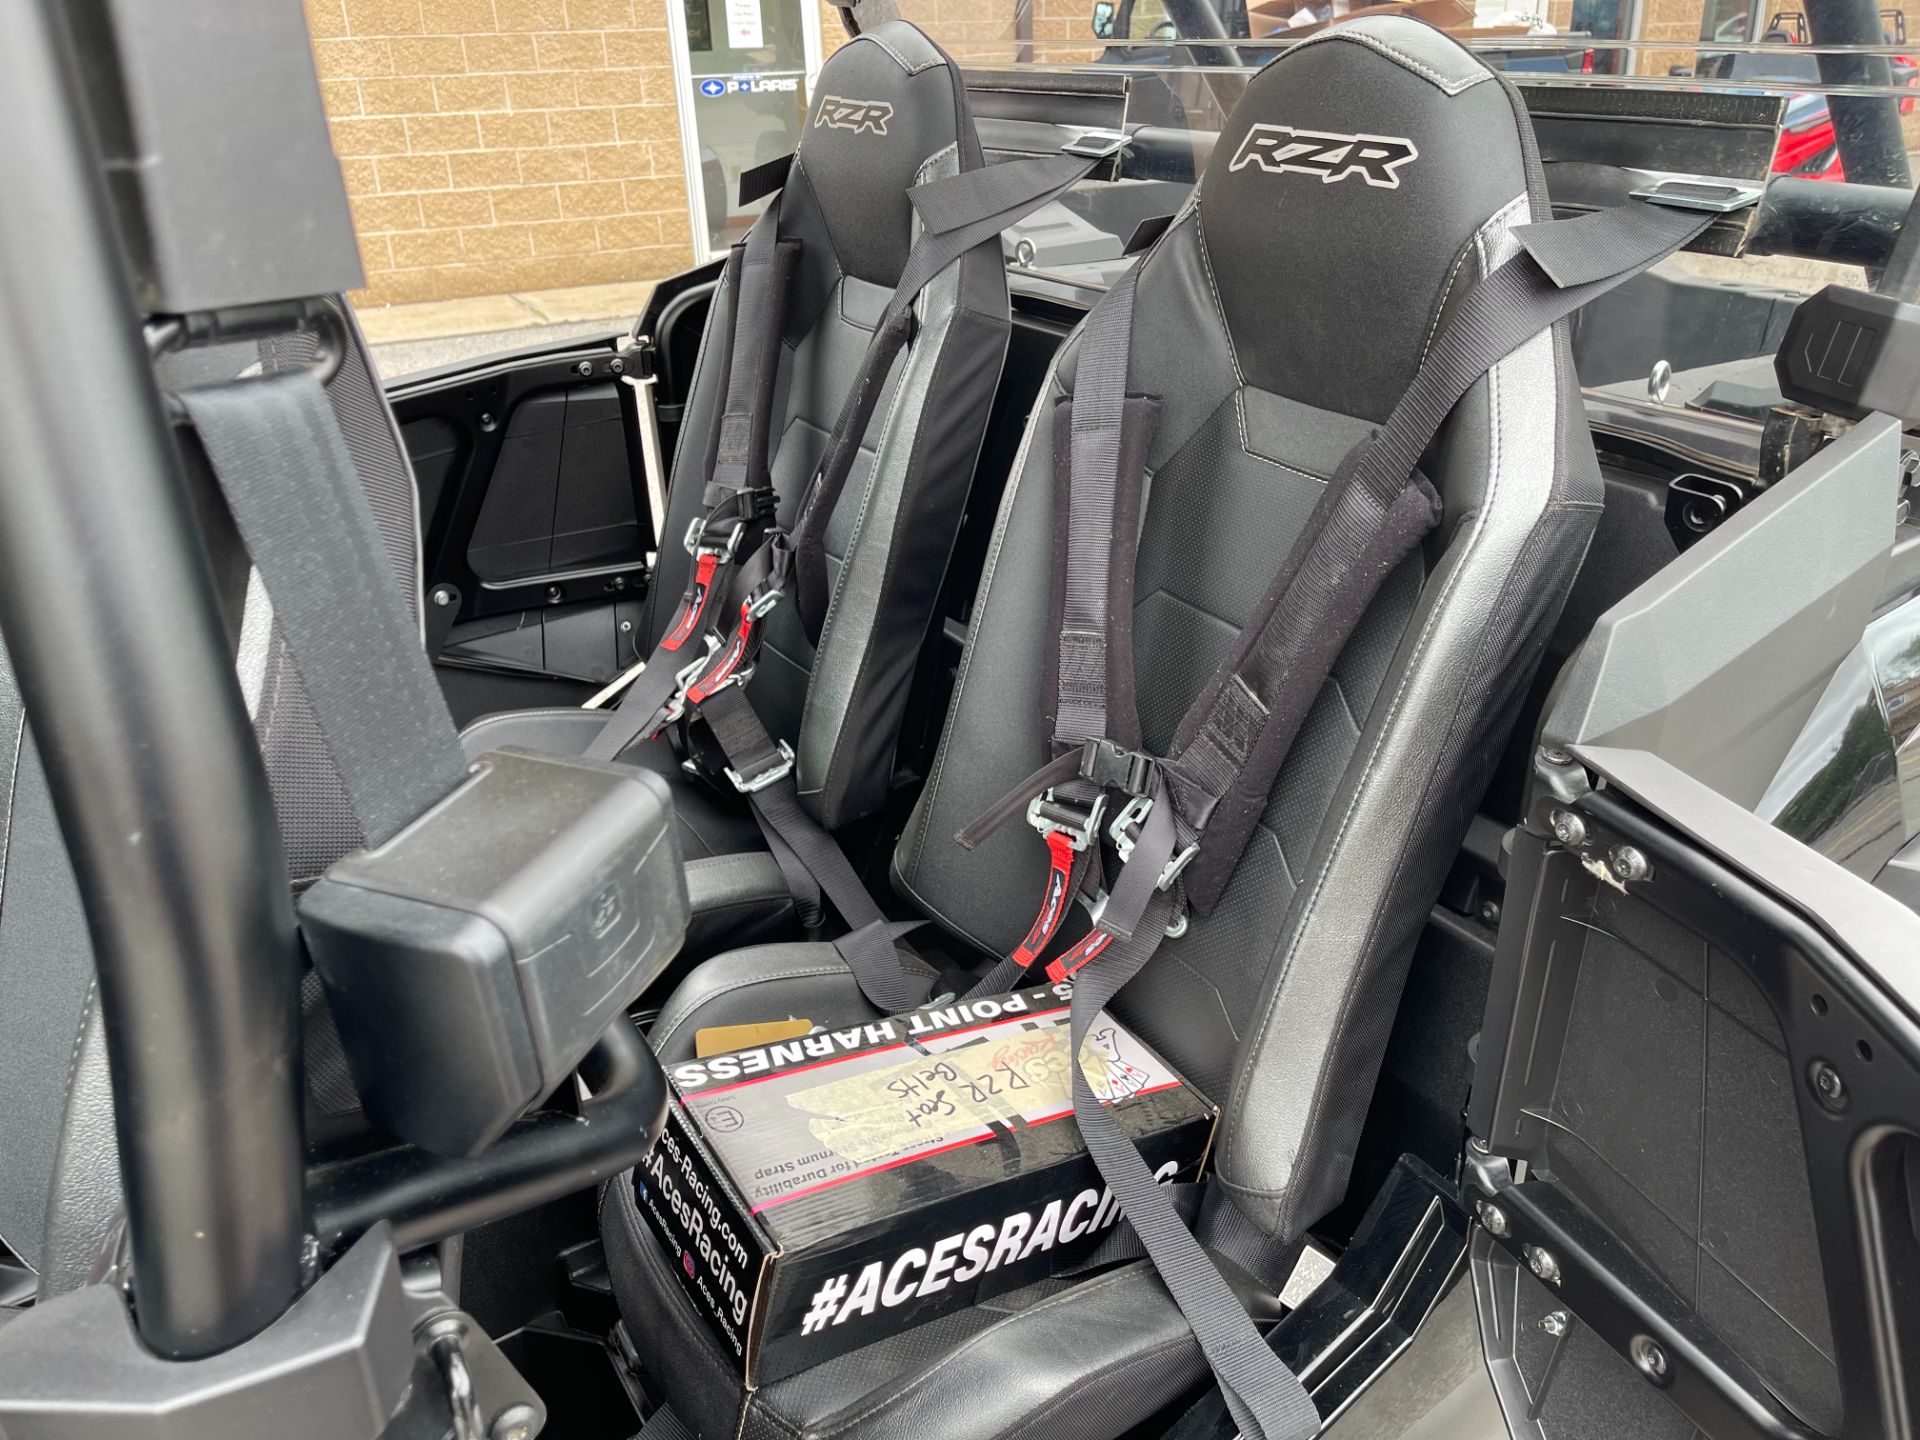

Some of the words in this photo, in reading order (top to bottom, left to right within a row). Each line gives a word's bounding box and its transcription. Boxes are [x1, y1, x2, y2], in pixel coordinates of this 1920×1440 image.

[814, 95, 894, 136] RZR
[1229, 123, 1418, 189] RZR
[908, 993, 1028, 1035] POINT
[674, 1021, 897, 1087] HARNESS
[753, 1168, 828, 1199] Durability
[754, 1161, 794, 1179] Strap
[830, 1160, 851, 1175] for
[661, 1128, 749, 1269] ces-Racing.com
